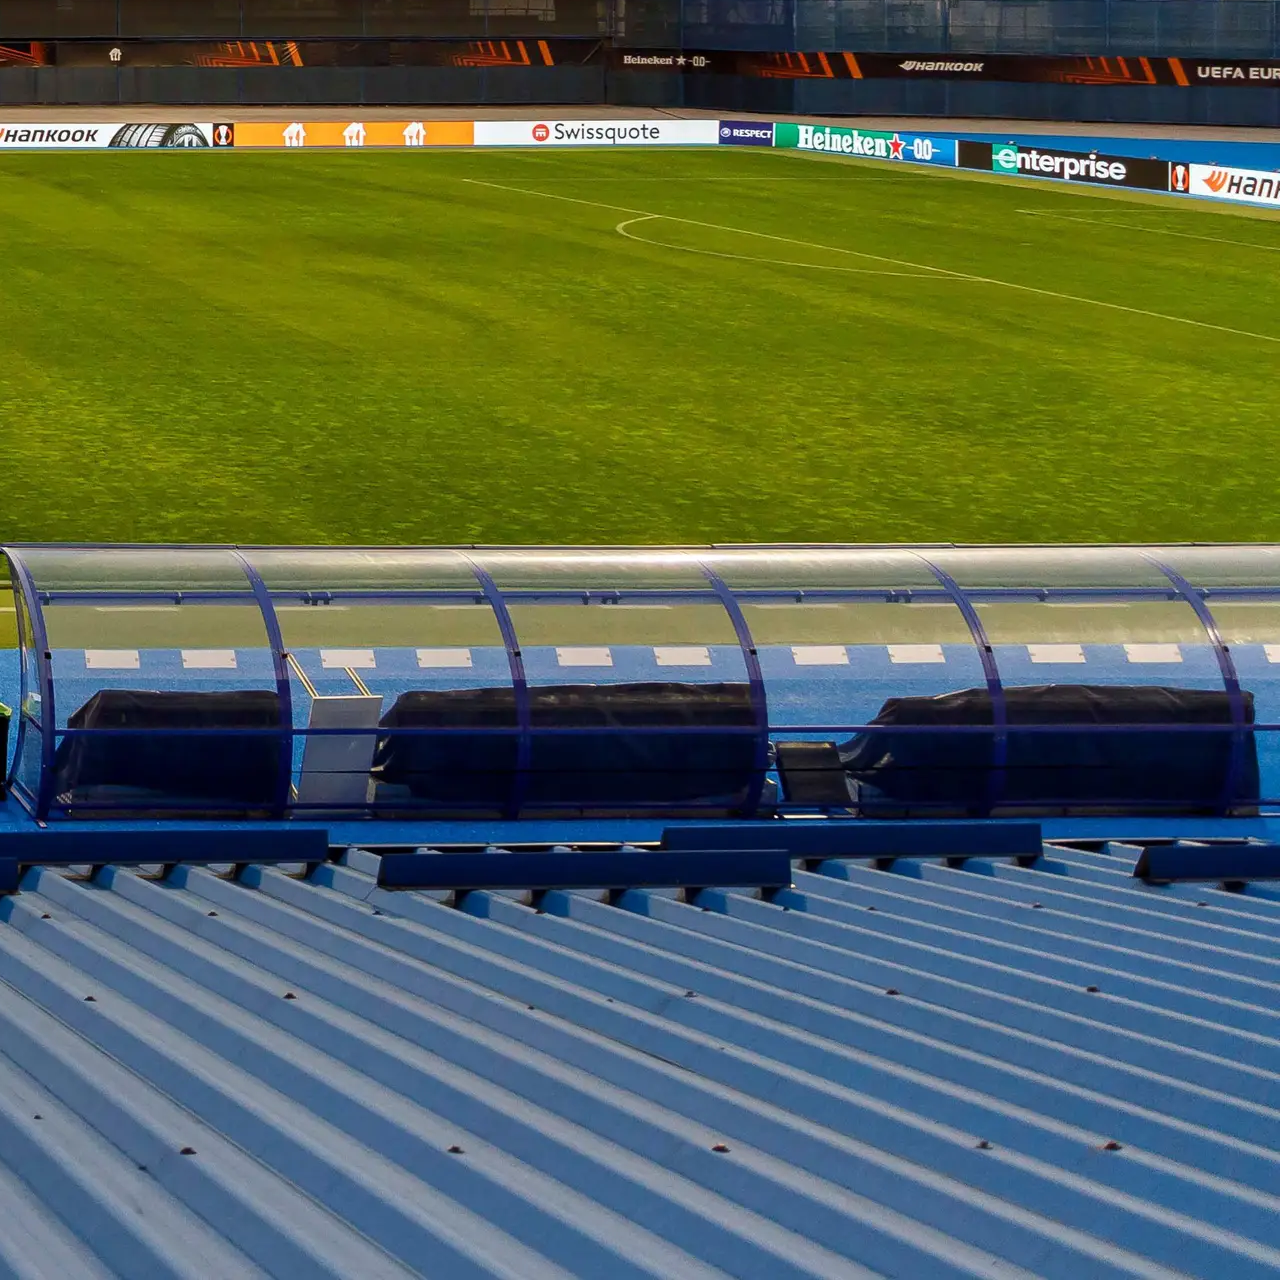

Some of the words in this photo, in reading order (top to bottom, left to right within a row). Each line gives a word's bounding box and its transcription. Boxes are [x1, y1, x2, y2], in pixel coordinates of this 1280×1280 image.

[624, 55, 673, 65] Heineken
[1198, 67, 1244, 78] UEFA
[555, 122, 660, 145] Swissquote
[733, 129, 772, 138] RESPECT
[798, 125, 886, 157] Heineken
[999, 148, 1127, 180] enterprise
